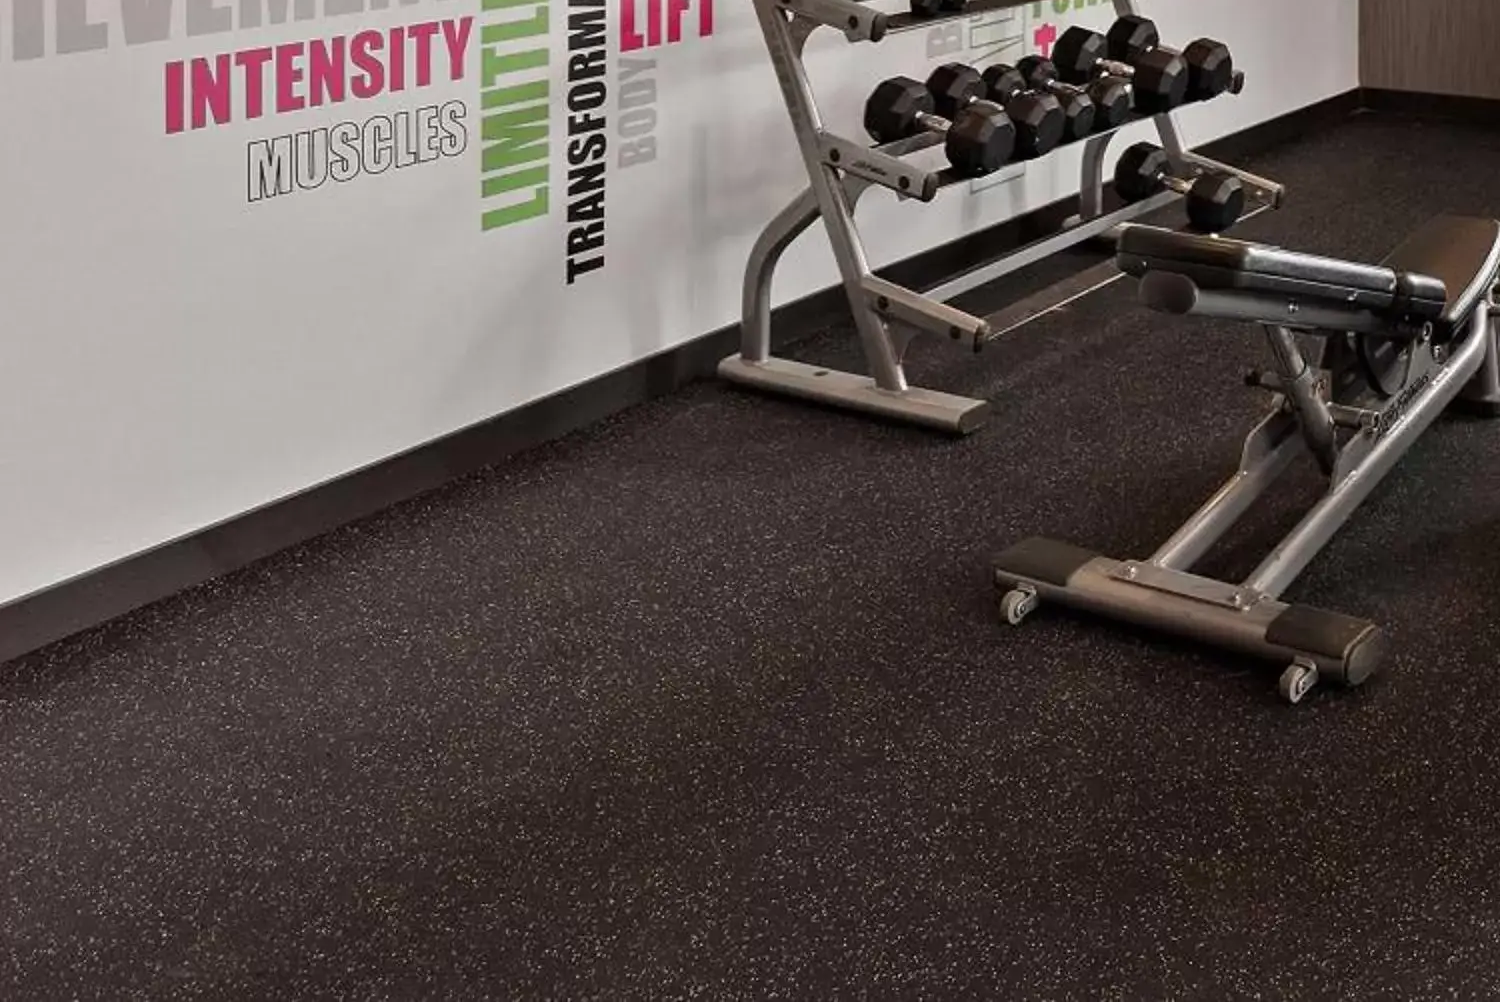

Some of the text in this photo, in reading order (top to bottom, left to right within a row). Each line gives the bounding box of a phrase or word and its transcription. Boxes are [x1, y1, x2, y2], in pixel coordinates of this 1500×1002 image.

[164, 15, 473, 135] INTENSITY
[617, 56, 658, 170] BODY
[247, 99, 468, 203] MUSCLES
